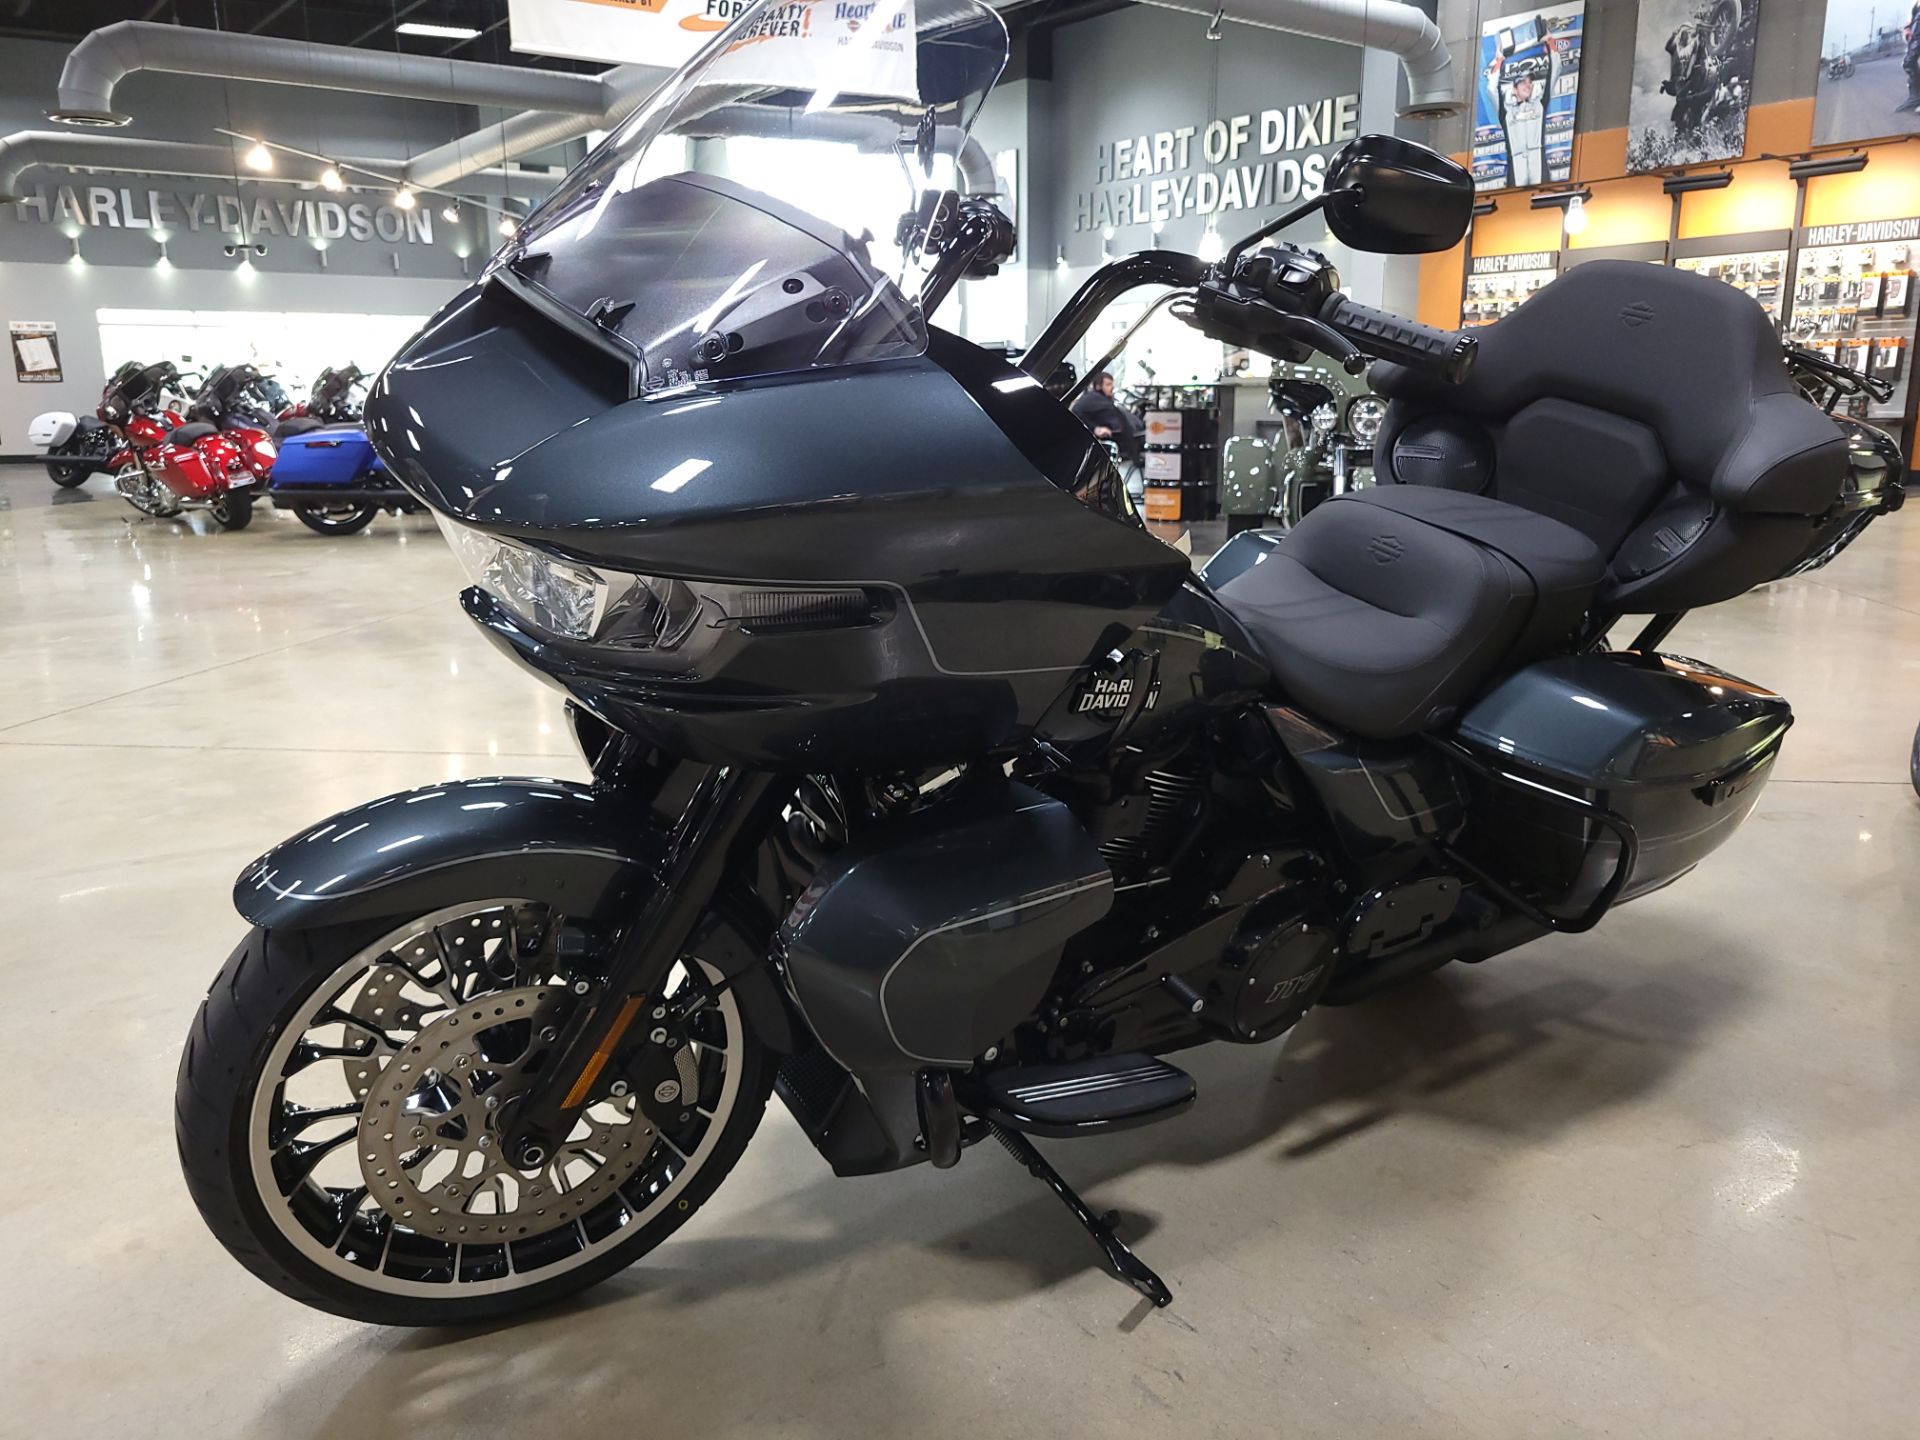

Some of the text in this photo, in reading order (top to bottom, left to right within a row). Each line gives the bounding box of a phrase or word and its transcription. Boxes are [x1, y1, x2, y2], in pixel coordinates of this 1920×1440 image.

[706, 0, 743, 18] FOR
[756, 4, 808, 24] RANTY
[740, 8, 812, 39] REVER!
[1096, 94, 1359, 184] HEART OF DIXIE
[1076, 153, 1326, 232] HARLEY-DAVIDS
[15, 184, 434, 245] HARLEY-DAVIDSON
[1808, 218, 1920, 246] HARLEY-DAVIDSON
[1473, 252, 1551, 273] HARLEY-DAVIDSON
[1094, 679, 1134, 693] HAR
[1078, 691, 1158, 712] DAVIDN
